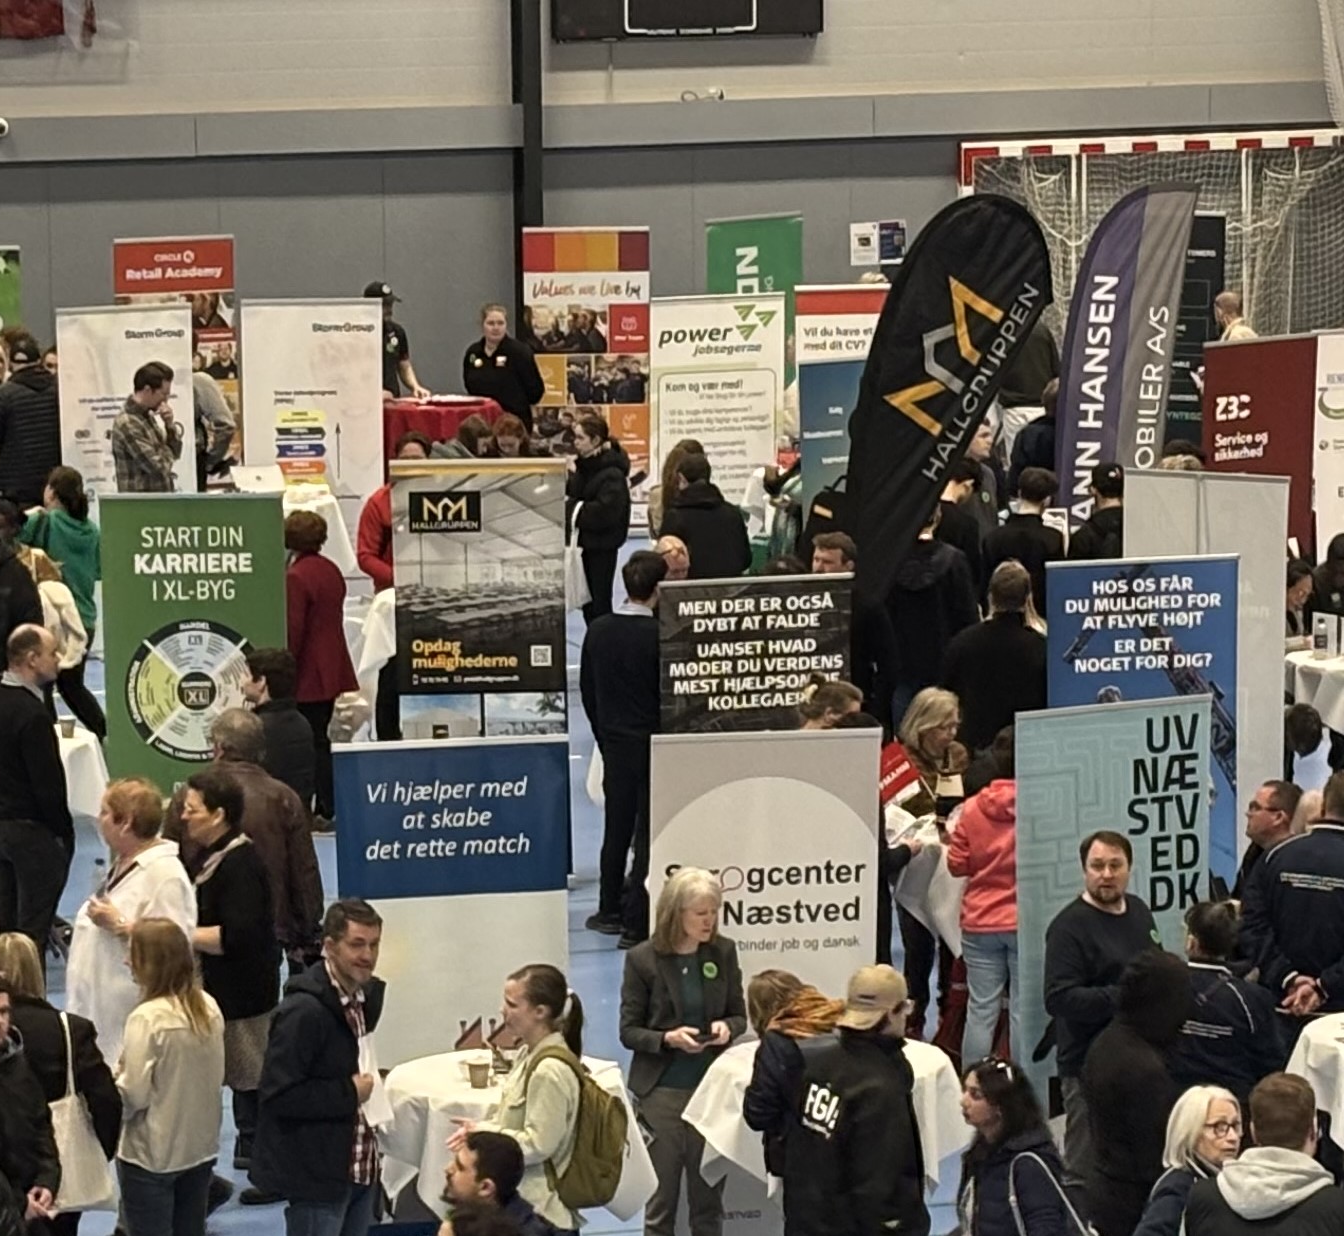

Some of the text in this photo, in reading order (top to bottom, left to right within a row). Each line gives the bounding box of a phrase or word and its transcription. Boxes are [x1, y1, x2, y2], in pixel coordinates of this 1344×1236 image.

[154, 253, 181, 263] CIRCLE
[126, 266, 223, 281] Retail Academy
[532, 281, 575, 299] Values
[658, 325, 733, 350] power
[820, 326, 861, 337] du have
[845, 340, 867, 351] CV?
[1077, 275, 1119, 430] HANSEN
[665, 382, 687, 393] Kom
[141, 526, 244, 549] START DIN
[134, 552, 253, 575] KARRIERE
[163, 579, 236, 601] XL-BYG
[1091, 575, 1194, 595] HOS OS FÅR
[677, 591, 834, 617] MEN DER ER OGSÅ
[1065, 592, 1222, 614] DU MULIGHED FOR
[693, 612, 821, 634] DYBT AT FALDE
[1081, 611, 1205, 631] AT FLYVE HØJT
[412, 639, 462, 660] Opdag
[696, 638, 817, 658] UANSET HVAD
[1113, 637, 1174, 655] ER DET
[412, 653, 518, 671] mulighederne
[669, 654, 844, 678] MØDER DU VERDENS
[1074, 652, 1214, 674] NOGET FOR DIG?
[673, 680, 719, 696] MEST
[1145, 714, 1200, 754] UV
[1133, 752, 1199, 796] NÆ
[366, 775, 528, 807] Vi hjælper med
[401, 807, 493, 831] at skabe
[1126, 792, 1200, 836] STV
[365, 832, 531, 862] det rette match
[1150, 833, 1200, 872] ED
[1150, 871, 1201, 912] DK
[722, 896, 862, 926] Næstved
[803, 934, 861, 951] og dansk
